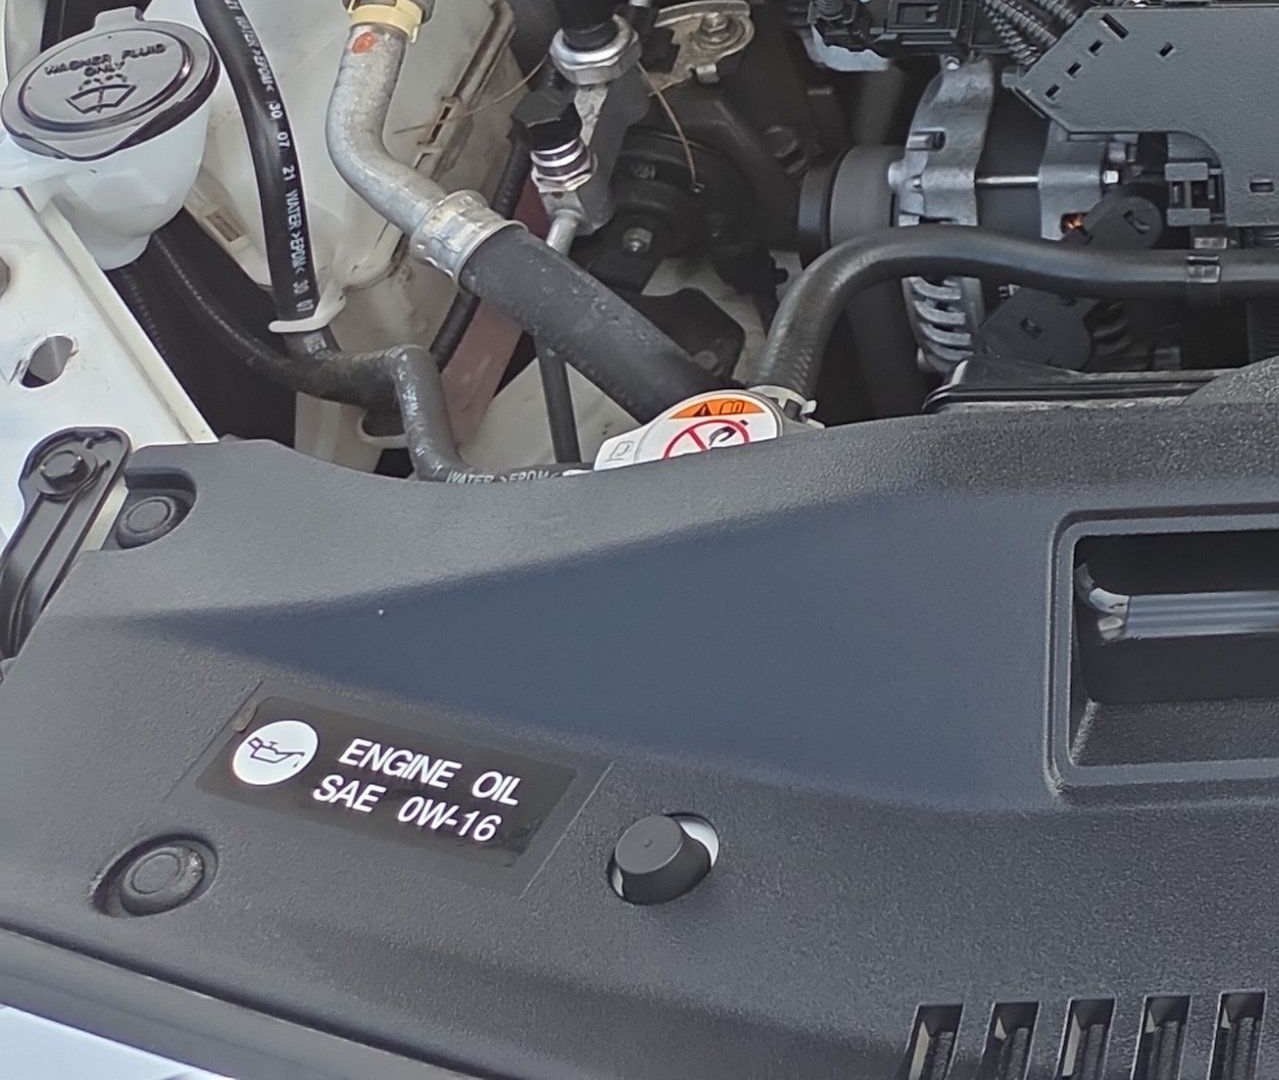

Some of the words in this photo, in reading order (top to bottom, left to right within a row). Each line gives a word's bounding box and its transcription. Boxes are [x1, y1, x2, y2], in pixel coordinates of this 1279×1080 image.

[84, 62, 125, 77] ONLY
[268, 103, 284, 120] 30
[277, 131, 291, 148] 07
[282, 165, 297, 181] 21
[285, 188, 302, 232] WATER
[339, 738, 462, 789] ENGINE
[472, 771, 521, 806] OIL
[313, 774, 387, 812] SAE
[398, 796, 502, 841] 0W-16
